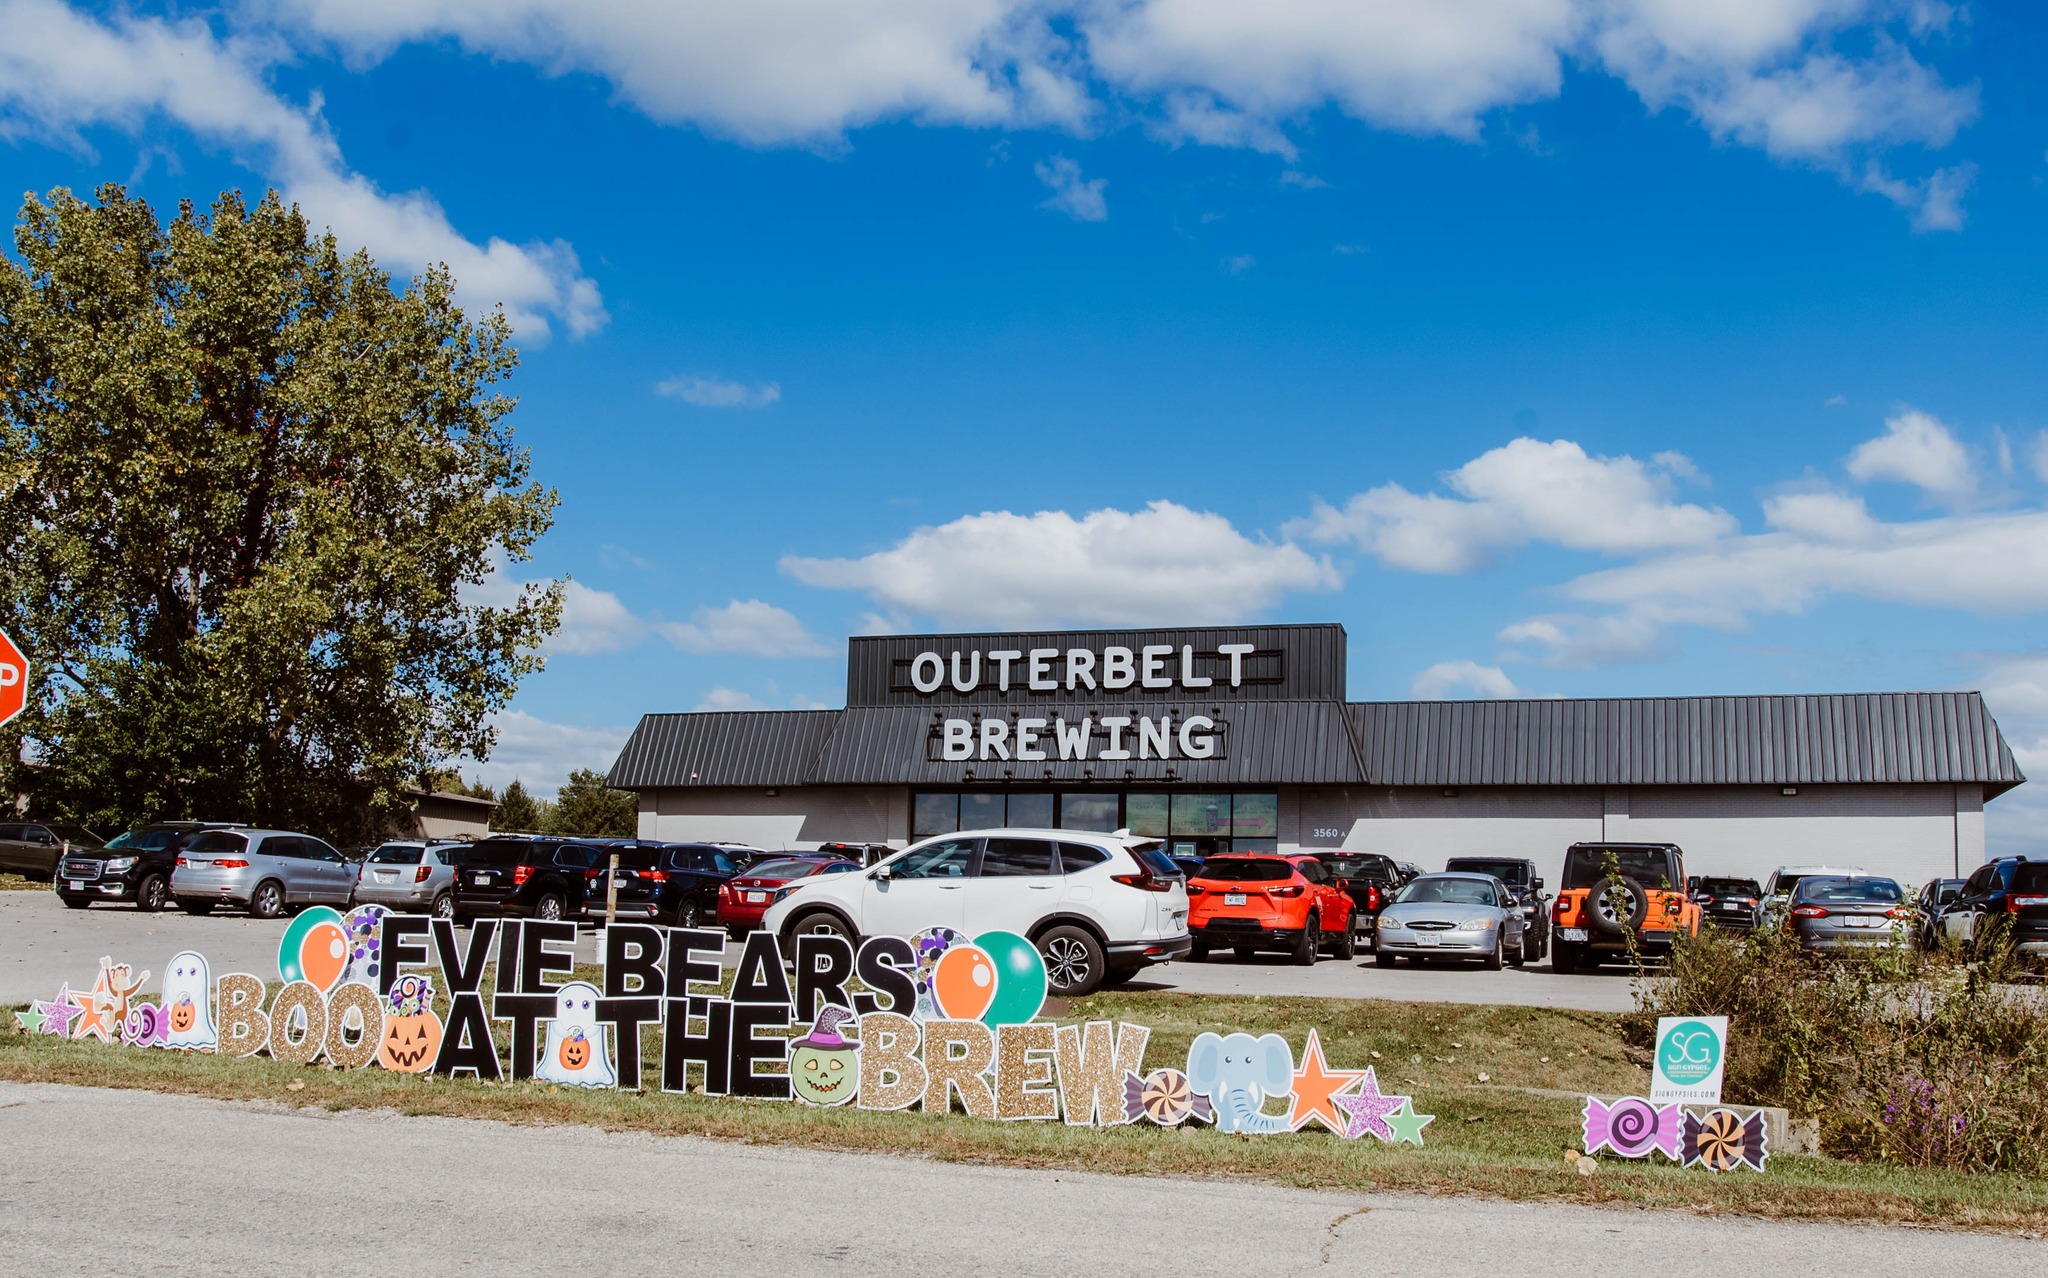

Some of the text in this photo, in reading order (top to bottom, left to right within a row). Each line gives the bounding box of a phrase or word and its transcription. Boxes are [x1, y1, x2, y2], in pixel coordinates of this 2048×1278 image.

[910, 643, 1255, 693] OUTERBELT
[943, 715, 1215, 761] BREWING
[1313, 828, 1338, 838] 3560
[379, 914, 918, 1026] EVIE BEARS
[215, 972, 1150, 1126] BOO AT THE BREW
[1667, 1031, 1711, 1063] SG
[1655, 1090, 1716, 1098] SIGNGYPSIES.COM
